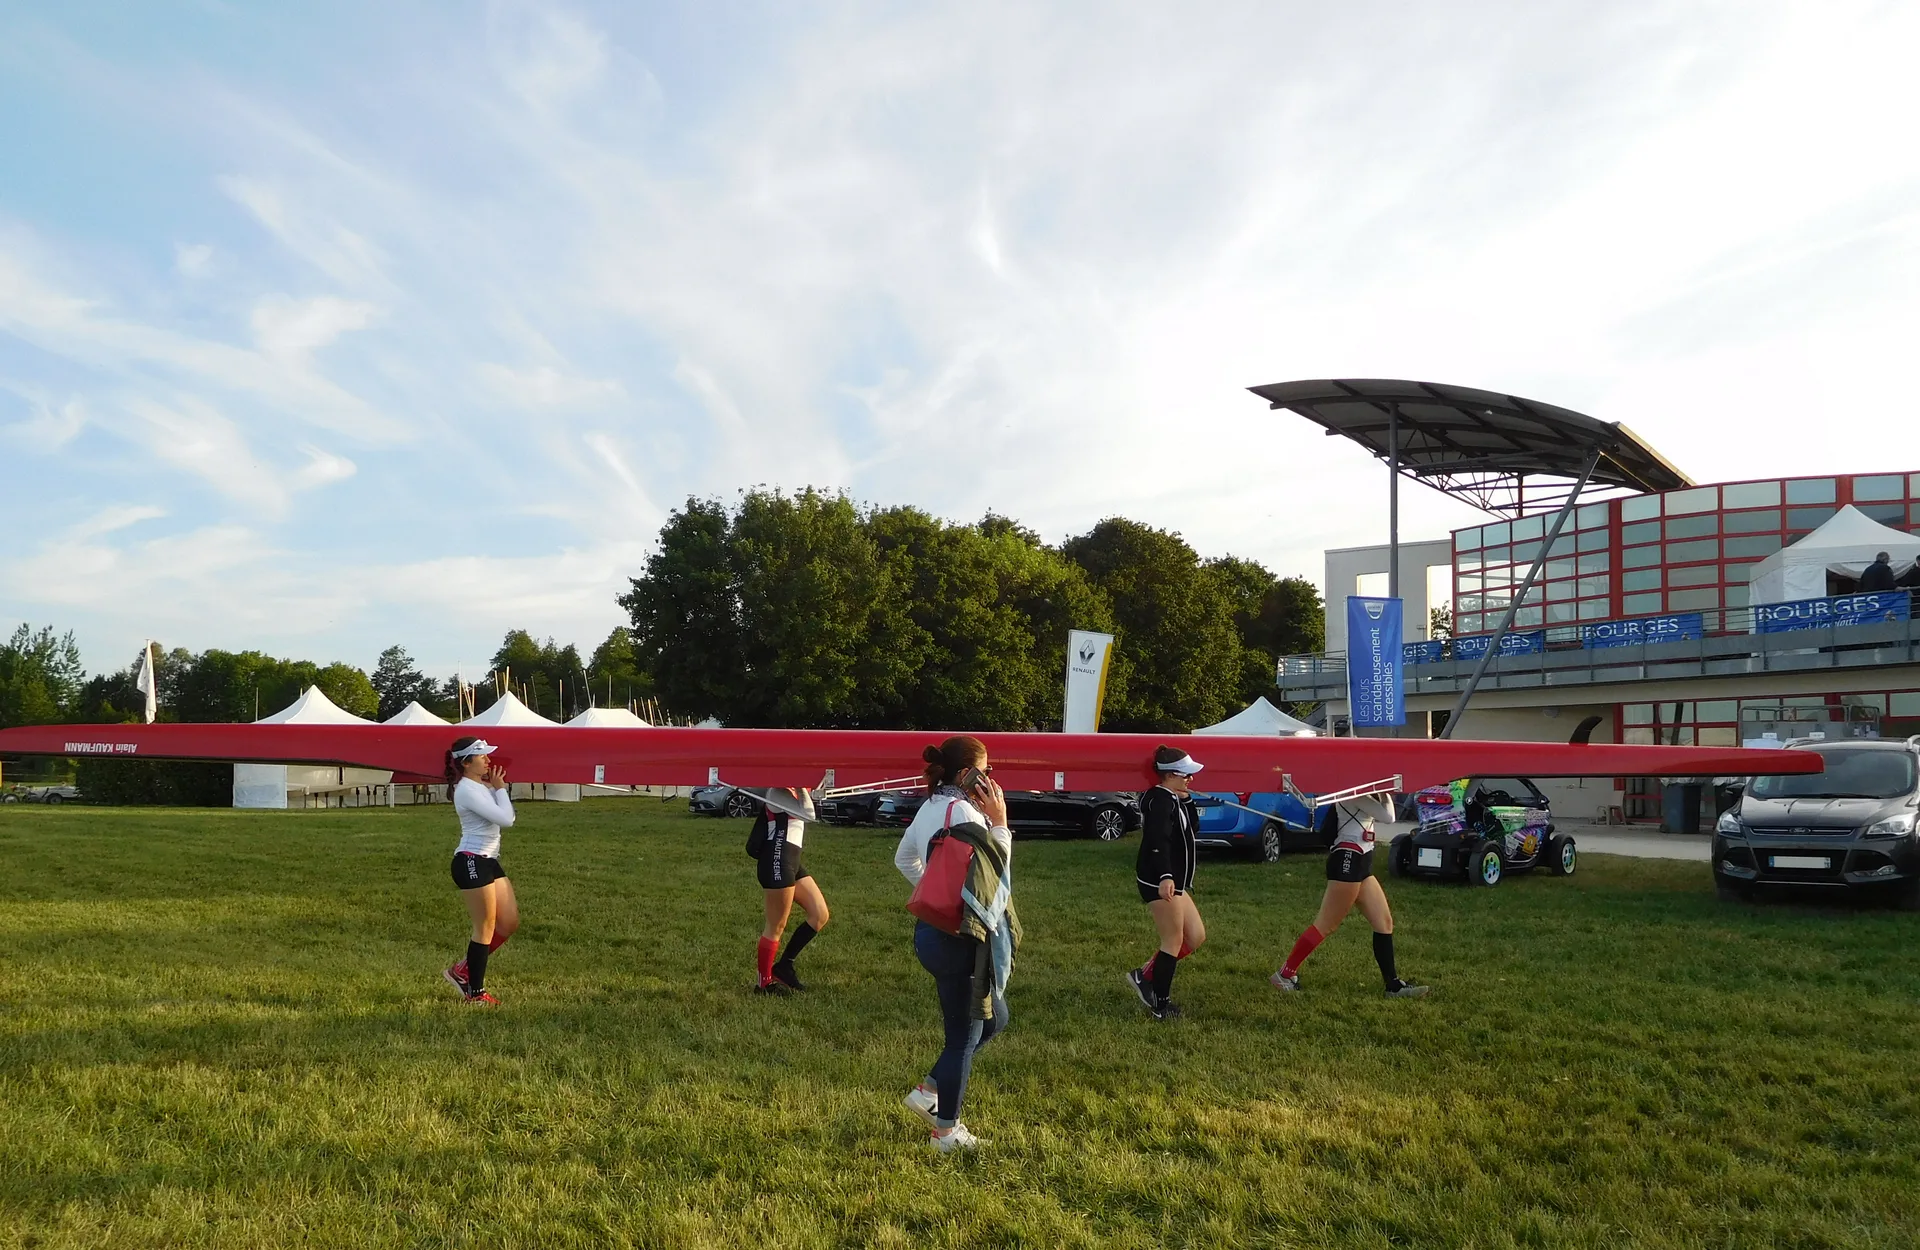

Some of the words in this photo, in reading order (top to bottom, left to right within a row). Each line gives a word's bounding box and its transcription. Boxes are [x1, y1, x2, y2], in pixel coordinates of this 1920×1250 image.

[1758, 595, 1880, 623] BOURGES
[1585, 618, 1679, 640] BOURGES
[1072, 667, 1096, 675] RENAULT
[1370, 627, 1382, 722] scandaleusement
[1358, 678, 1372, 703] jours
[1383, 661, 1394, 722] accessibles
[1358, 705, 1370, 723] Les
[64, 742, 114, 753] KAUFMANN
[115, 743, 138, 753] Alain
